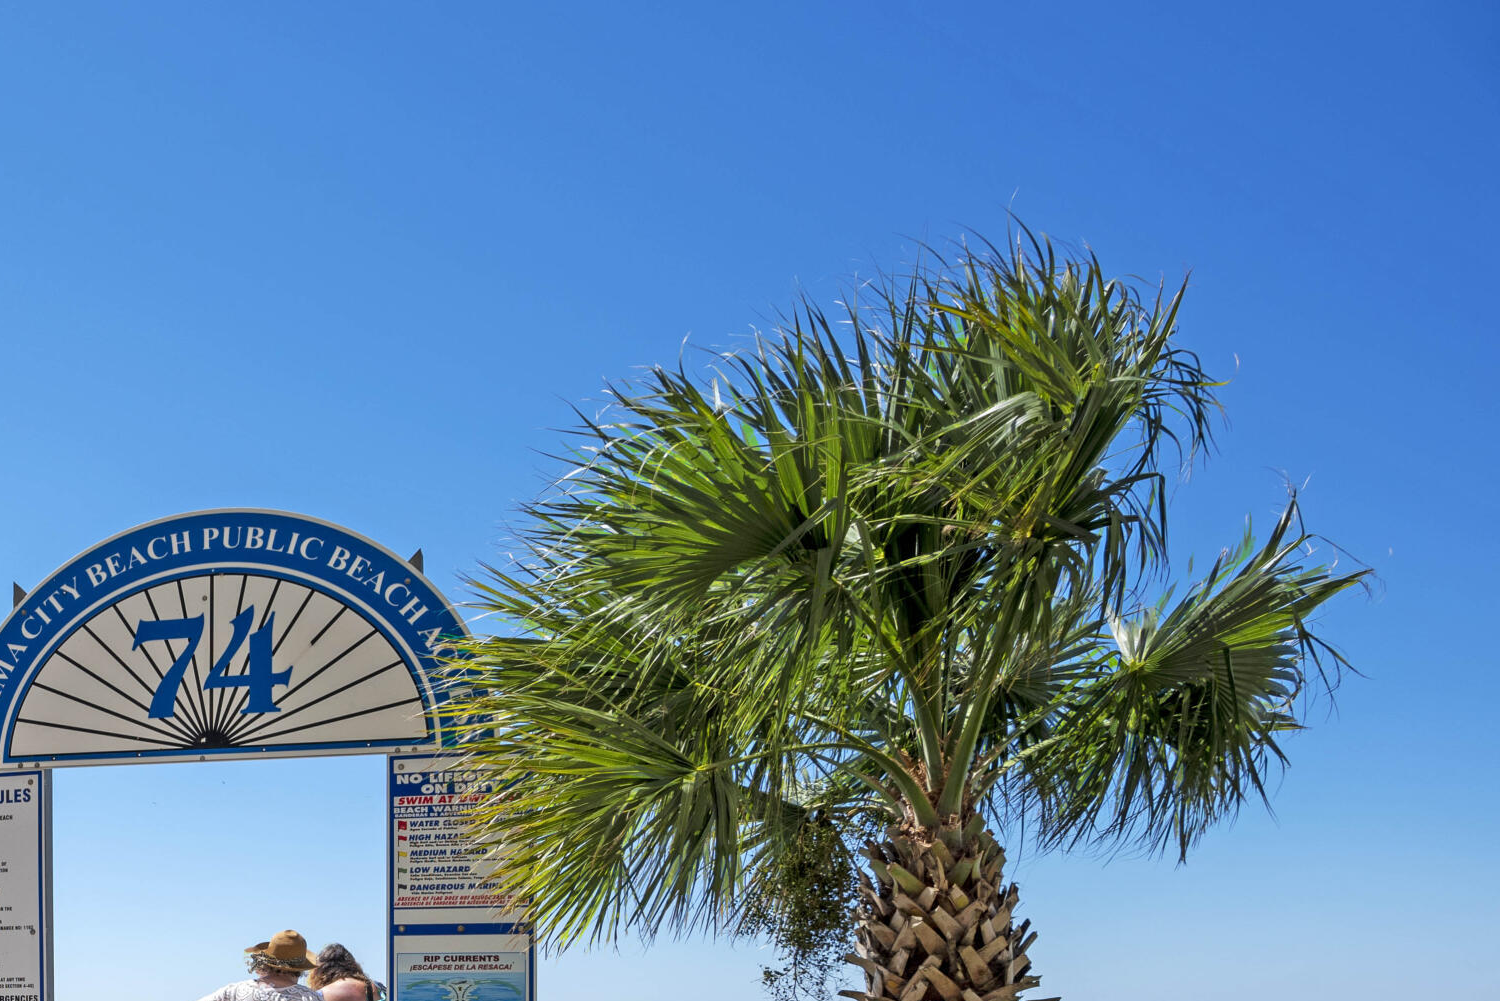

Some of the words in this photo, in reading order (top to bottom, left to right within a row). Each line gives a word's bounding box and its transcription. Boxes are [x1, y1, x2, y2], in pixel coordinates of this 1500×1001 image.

[21, 576, 81, 640] CITY
[85, 530, 192, 587] BEACH
[202, 526, 325, 561] PUBLIC
[326, 545, 429, 626] BEACH
[131, 604, 294, 719] 74
[397, 774, 423, 784] NO
[421, 784, 448, 794] ON
[398, 796, 434, 805] SWIM
[438, 795, 454, 803] AT
[410, 963, 453, 972] ¡ESCÁPESE
